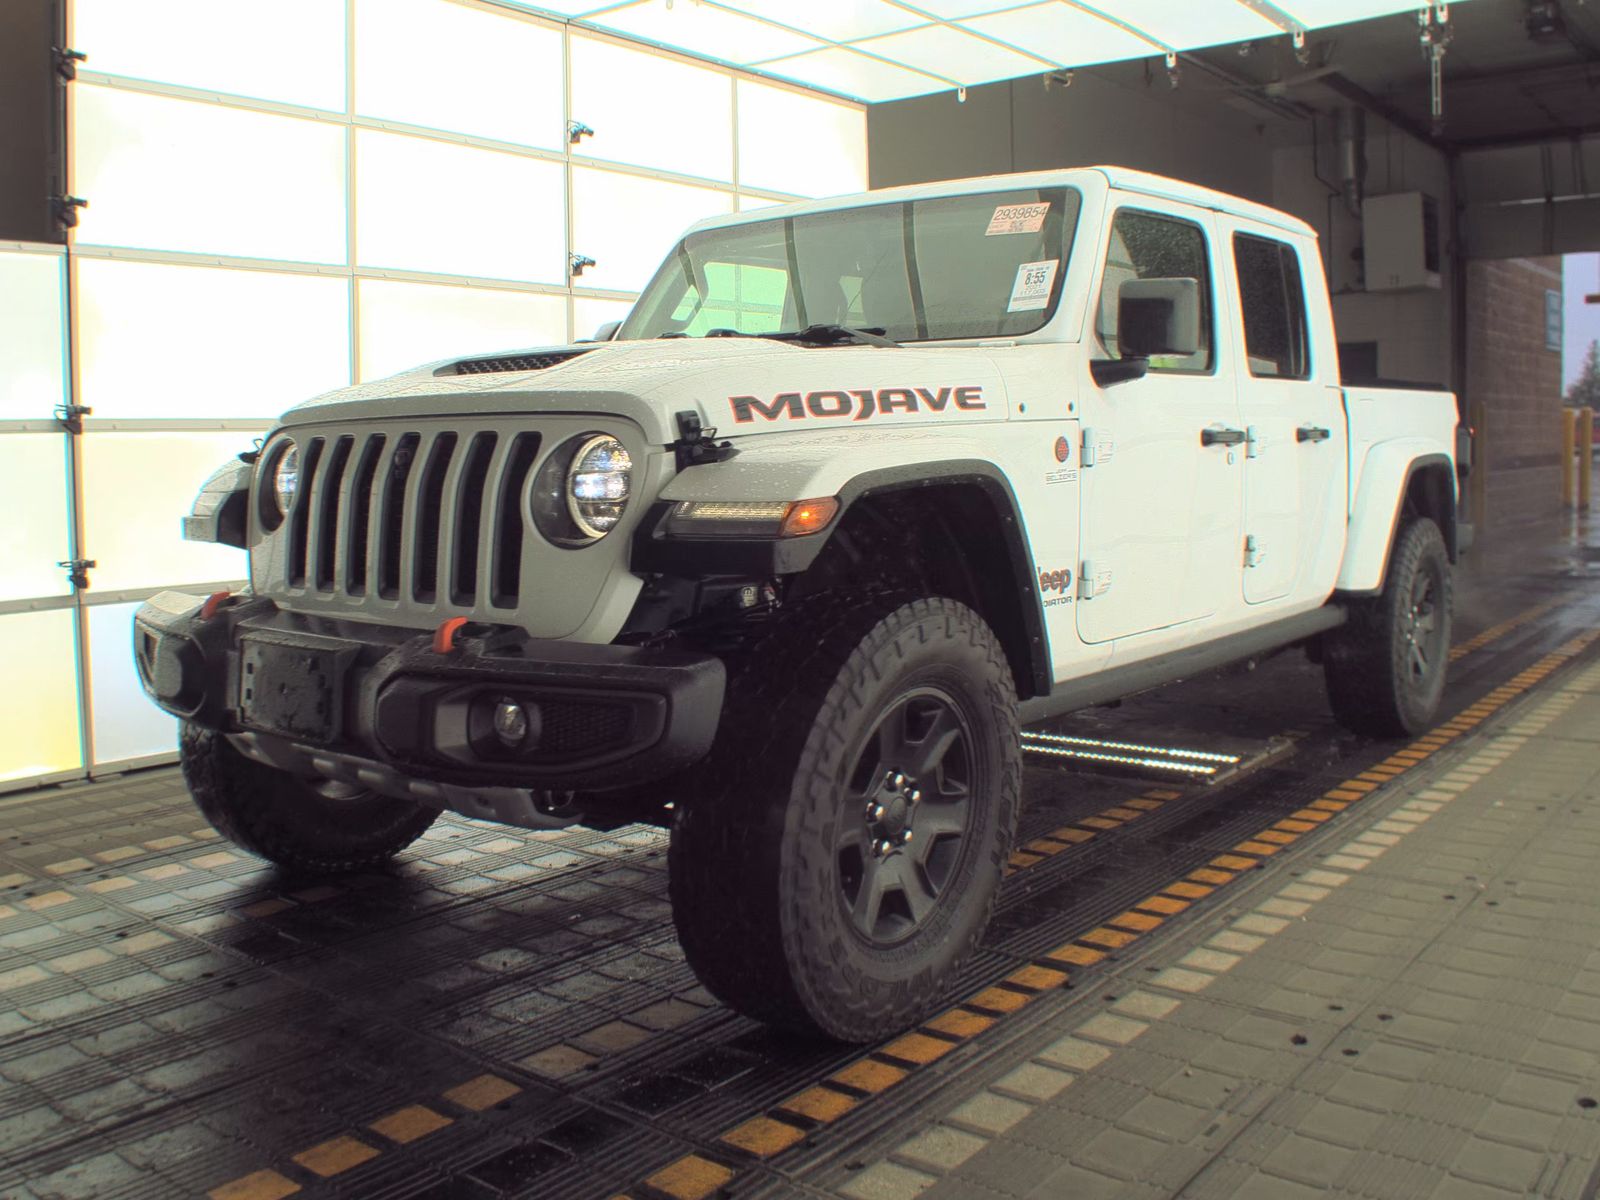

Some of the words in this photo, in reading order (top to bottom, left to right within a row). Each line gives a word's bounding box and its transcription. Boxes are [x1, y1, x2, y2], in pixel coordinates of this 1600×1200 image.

[994, 206, 1048, 220] 2939854
[1025, 270, 1046, 285] 8:55
[728, 386, 987, 423] MOJAVE
